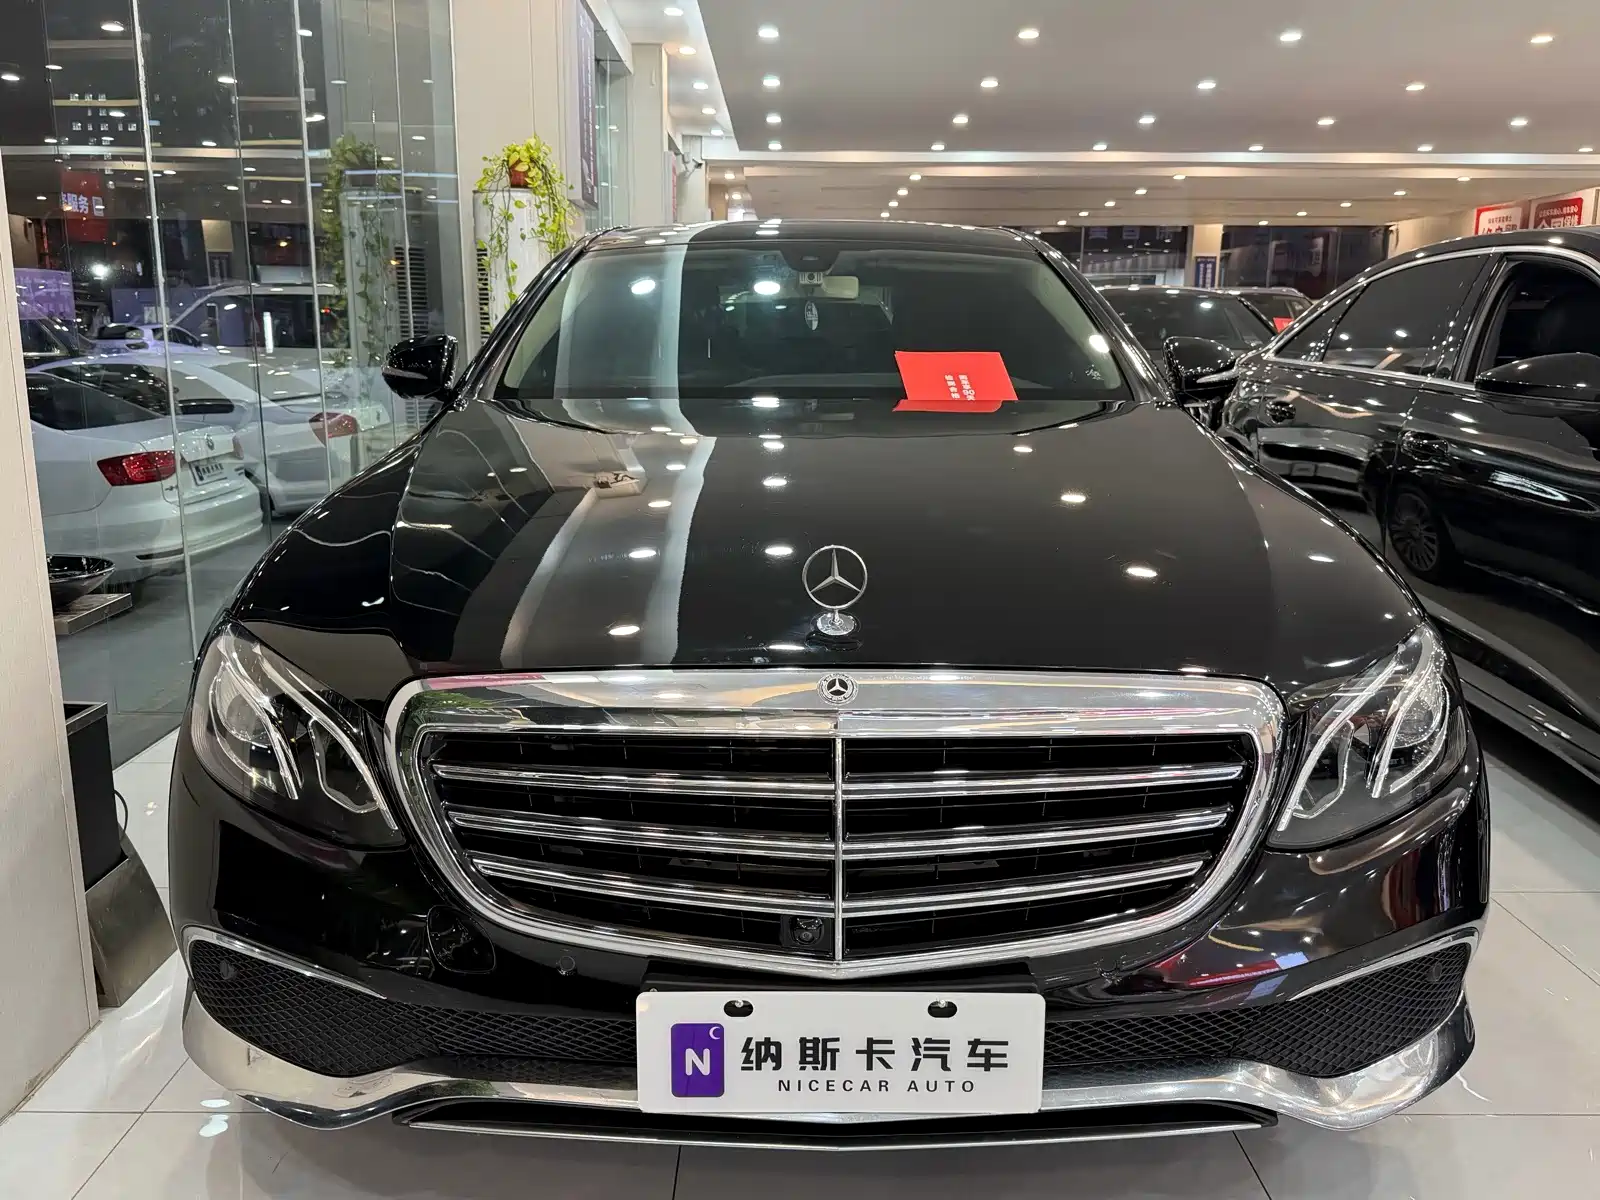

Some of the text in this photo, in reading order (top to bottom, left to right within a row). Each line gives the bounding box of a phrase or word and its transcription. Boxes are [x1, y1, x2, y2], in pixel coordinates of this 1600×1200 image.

[685, 1048, 711, 1076] N
[741, 1036, 1009, 1071] 纳斯卡汽车
[778, 1079, 975, 1093] NICECAR AUTO
